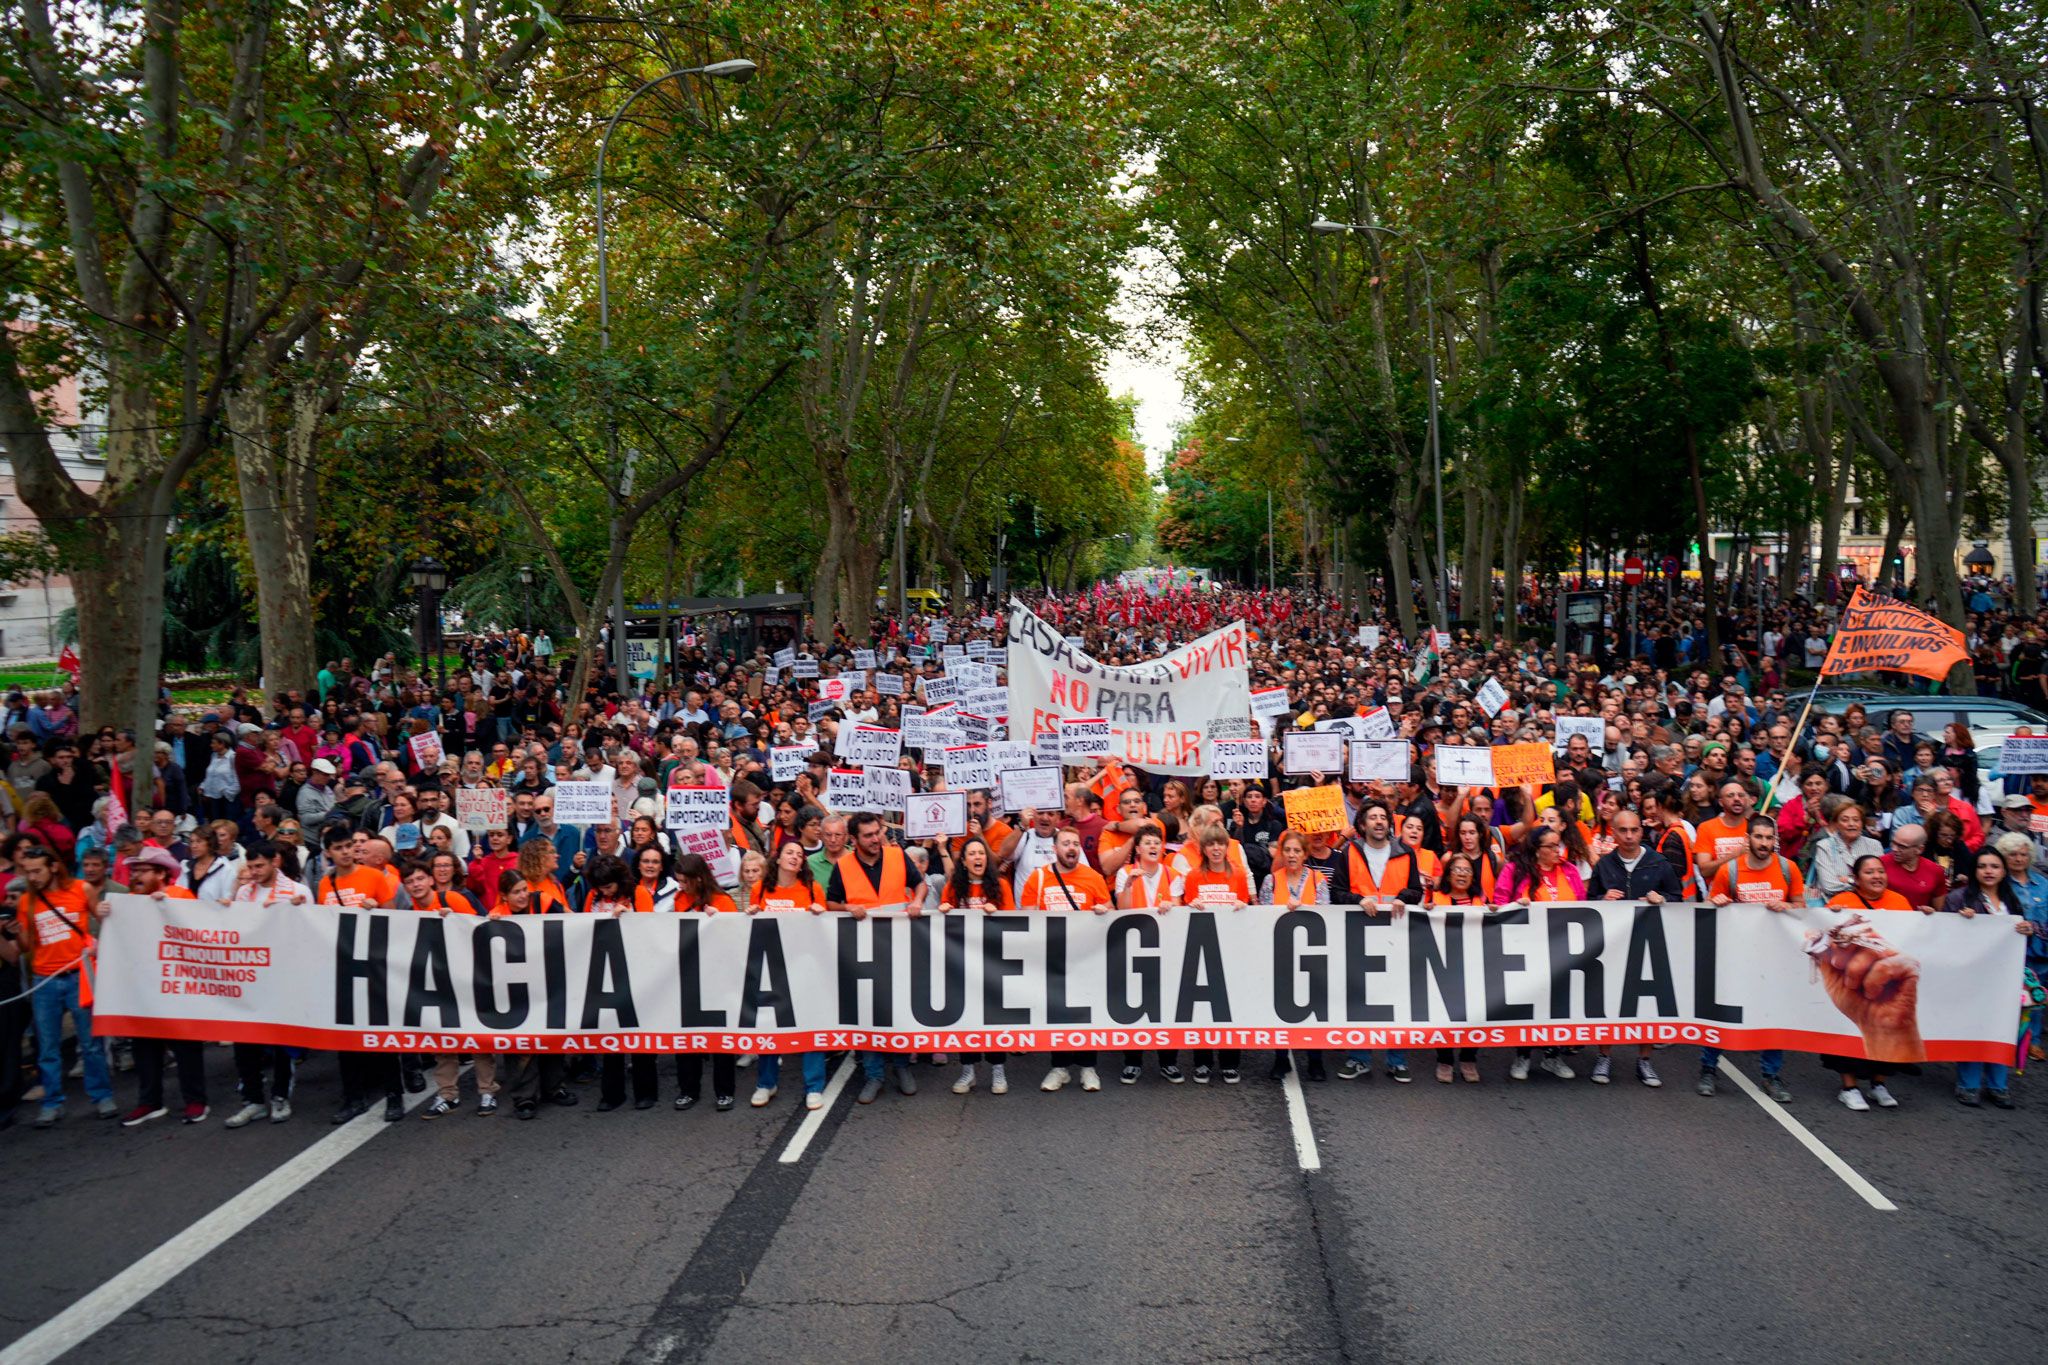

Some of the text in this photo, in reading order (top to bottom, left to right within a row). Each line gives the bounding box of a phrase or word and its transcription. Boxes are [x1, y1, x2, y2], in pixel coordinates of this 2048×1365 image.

[1009, 604, 1093, 673] CASAS
[1838, 633, 1947, 653] E INQUILINOS
[926, 679, 954, 691] DERECHO
[933, 686, 956, 698] TECHO
[1050, 669, 1176, 724] NO PARA
[1062, 726, 1072, 736] NO
[1081, 724, 1109, 735] FRAUDE
[1031, 708, 1201, 767] ESULAR
[849, 749, 862, 760] LO
[1212, 762, 1226, 774] LO
[830, 776, 840, 787] NO
[843, 778, 848, 788] al
[885, 771, 901, 786] NOS
[948, 771, 958, 785] LO
[670, 791, 726, 804] NO al FRAUDE
[670, 810, 726, 824] HIPOTECARIO!
[682, 830, 718, 844] POR UNA
[688, 840, 719, 852] HUELGA
[164, 925, 240, 945] SINDICATO
[162, 945, 268, 966] DE INQUILINAS
[162, 964, 256, 982] E INQUILINOS
[335, 906, 1743, 1030] HACIA LA HUELGA GENERAL
[161, 981, 242, 998] DE MADRID
[362, 1033, 484, 1051] BAJADA
[494, 1036, 548, 1051] DEL
[562, 1035, 708, 1052] ALQUILER
[721, 1034, 777, 1050] 50%
[814, 1028, 1036, 1050] EXPROPIACIÓN
[1050, 1030, 1170, 1047] FONDOS
[1184, 1030, 1290, 1046] BUITRE
[1326, 1028, 1506, 1046] CONTRATOS
[1520, 1024, 1721, 1044] INDEFINIDOS
